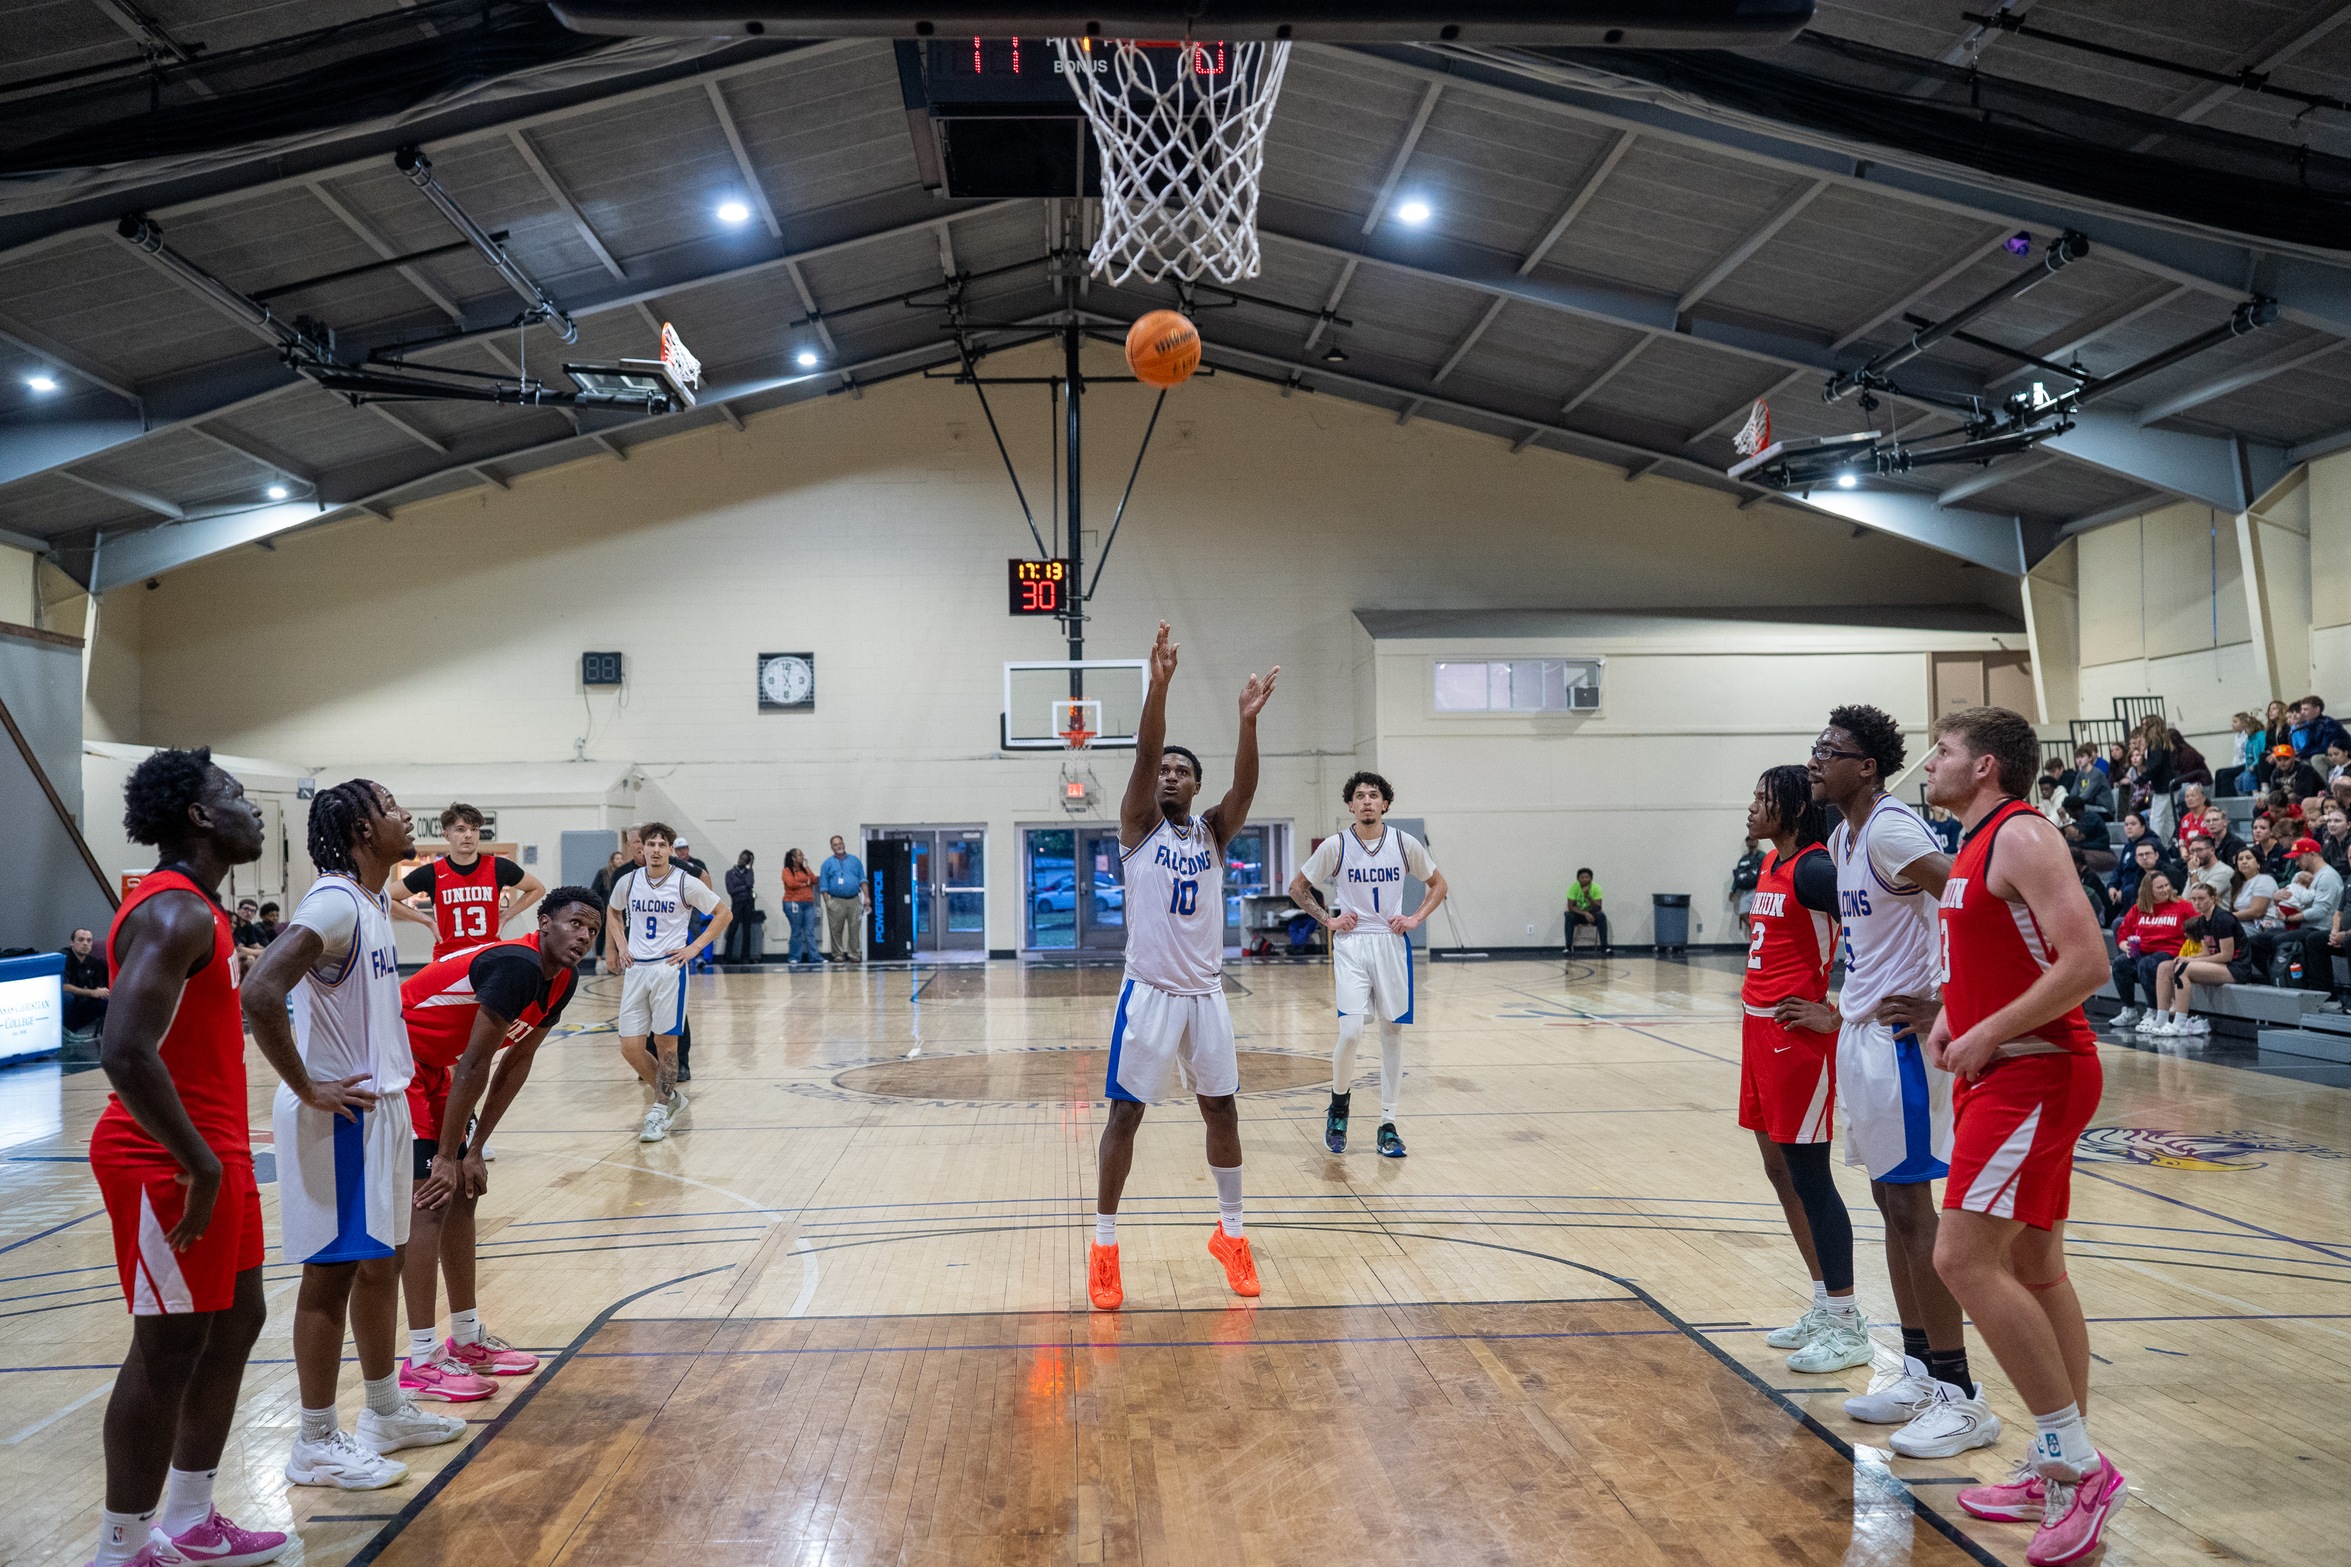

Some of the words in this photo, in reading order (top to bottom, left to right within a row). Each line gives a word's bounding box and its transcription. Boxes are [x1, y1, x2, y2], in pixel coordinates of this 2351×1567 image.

[1054, 59, 1108, 74] BONUS
[1022, 581, 1056, 610] 30
[1154, 845, 1211, 876] FALCONS
[1348, 867, 1400, 883] FALCONS
[442, 886, 493, 905] UNION
[631, 900, 675, 913] FALCONS
[873, 869, 885, 943] POWERADE
[1169, 877, 1199, 916] 10
[1372, 887, 1379, 914] 1
[452, 906, 487, 937] 13
[645, 916, 657, 939] 9
[2138, 916, 2178, 926] ALUMNI
